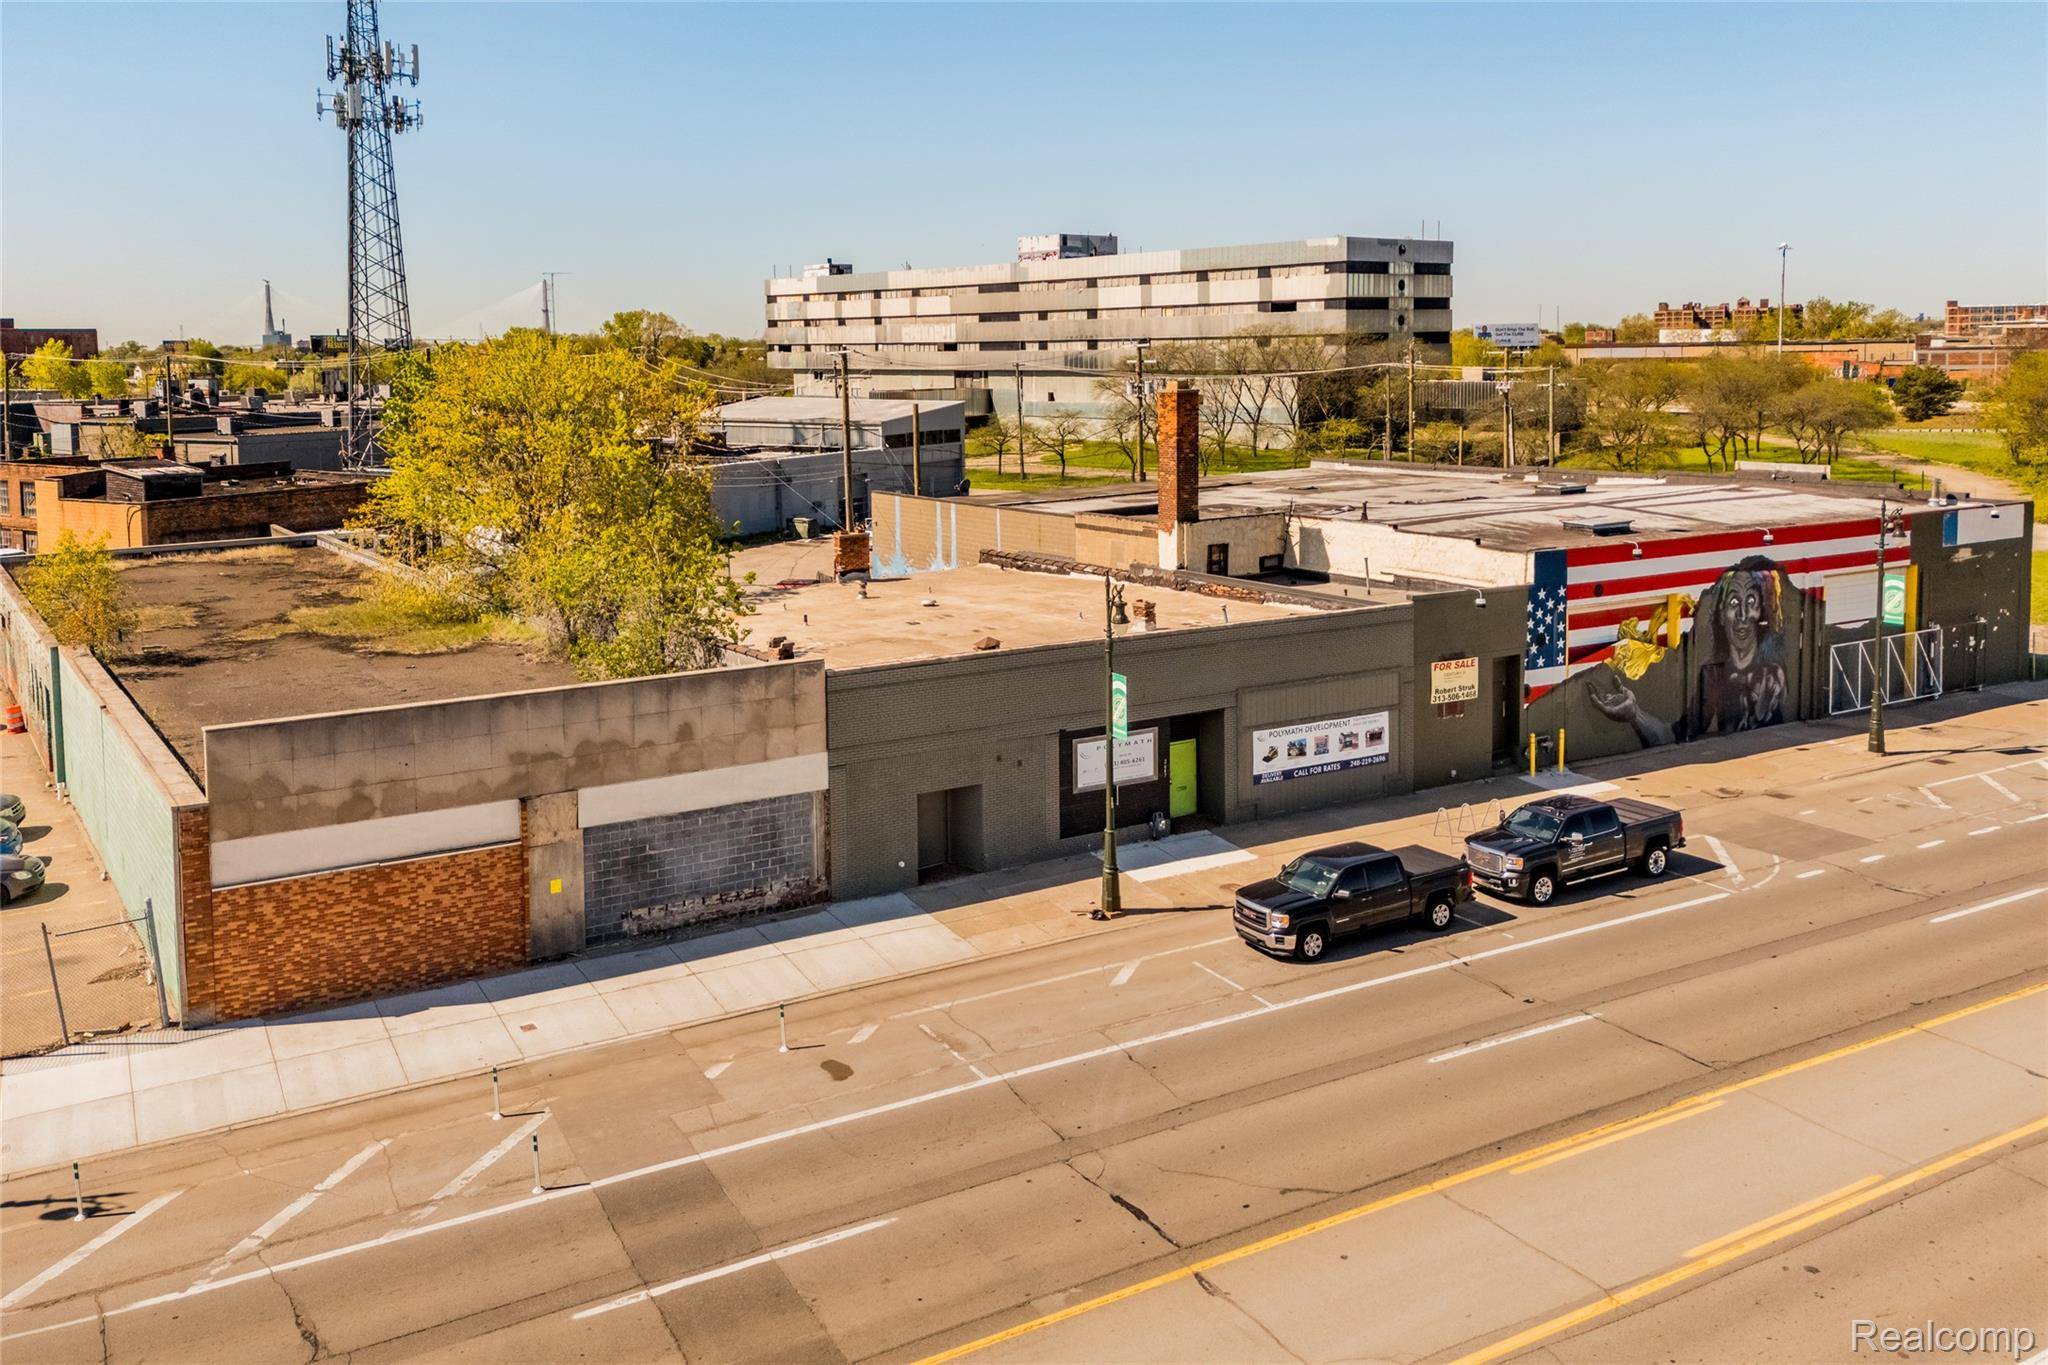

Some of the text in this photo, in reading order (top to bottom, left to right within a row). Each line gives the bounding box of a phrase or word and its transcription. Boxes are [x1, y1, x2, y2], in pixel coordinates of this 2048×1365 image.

[1434, 658, 1476, 671] FOR SALE
[1434, 686, 1456, 695] Robert
[1268, 728, 1303, 738] POLYMATH
[1305, 720, 1351, 732] DEVELOPMENT
[1294, 763, 1341, 778] CALL FOR RATES
